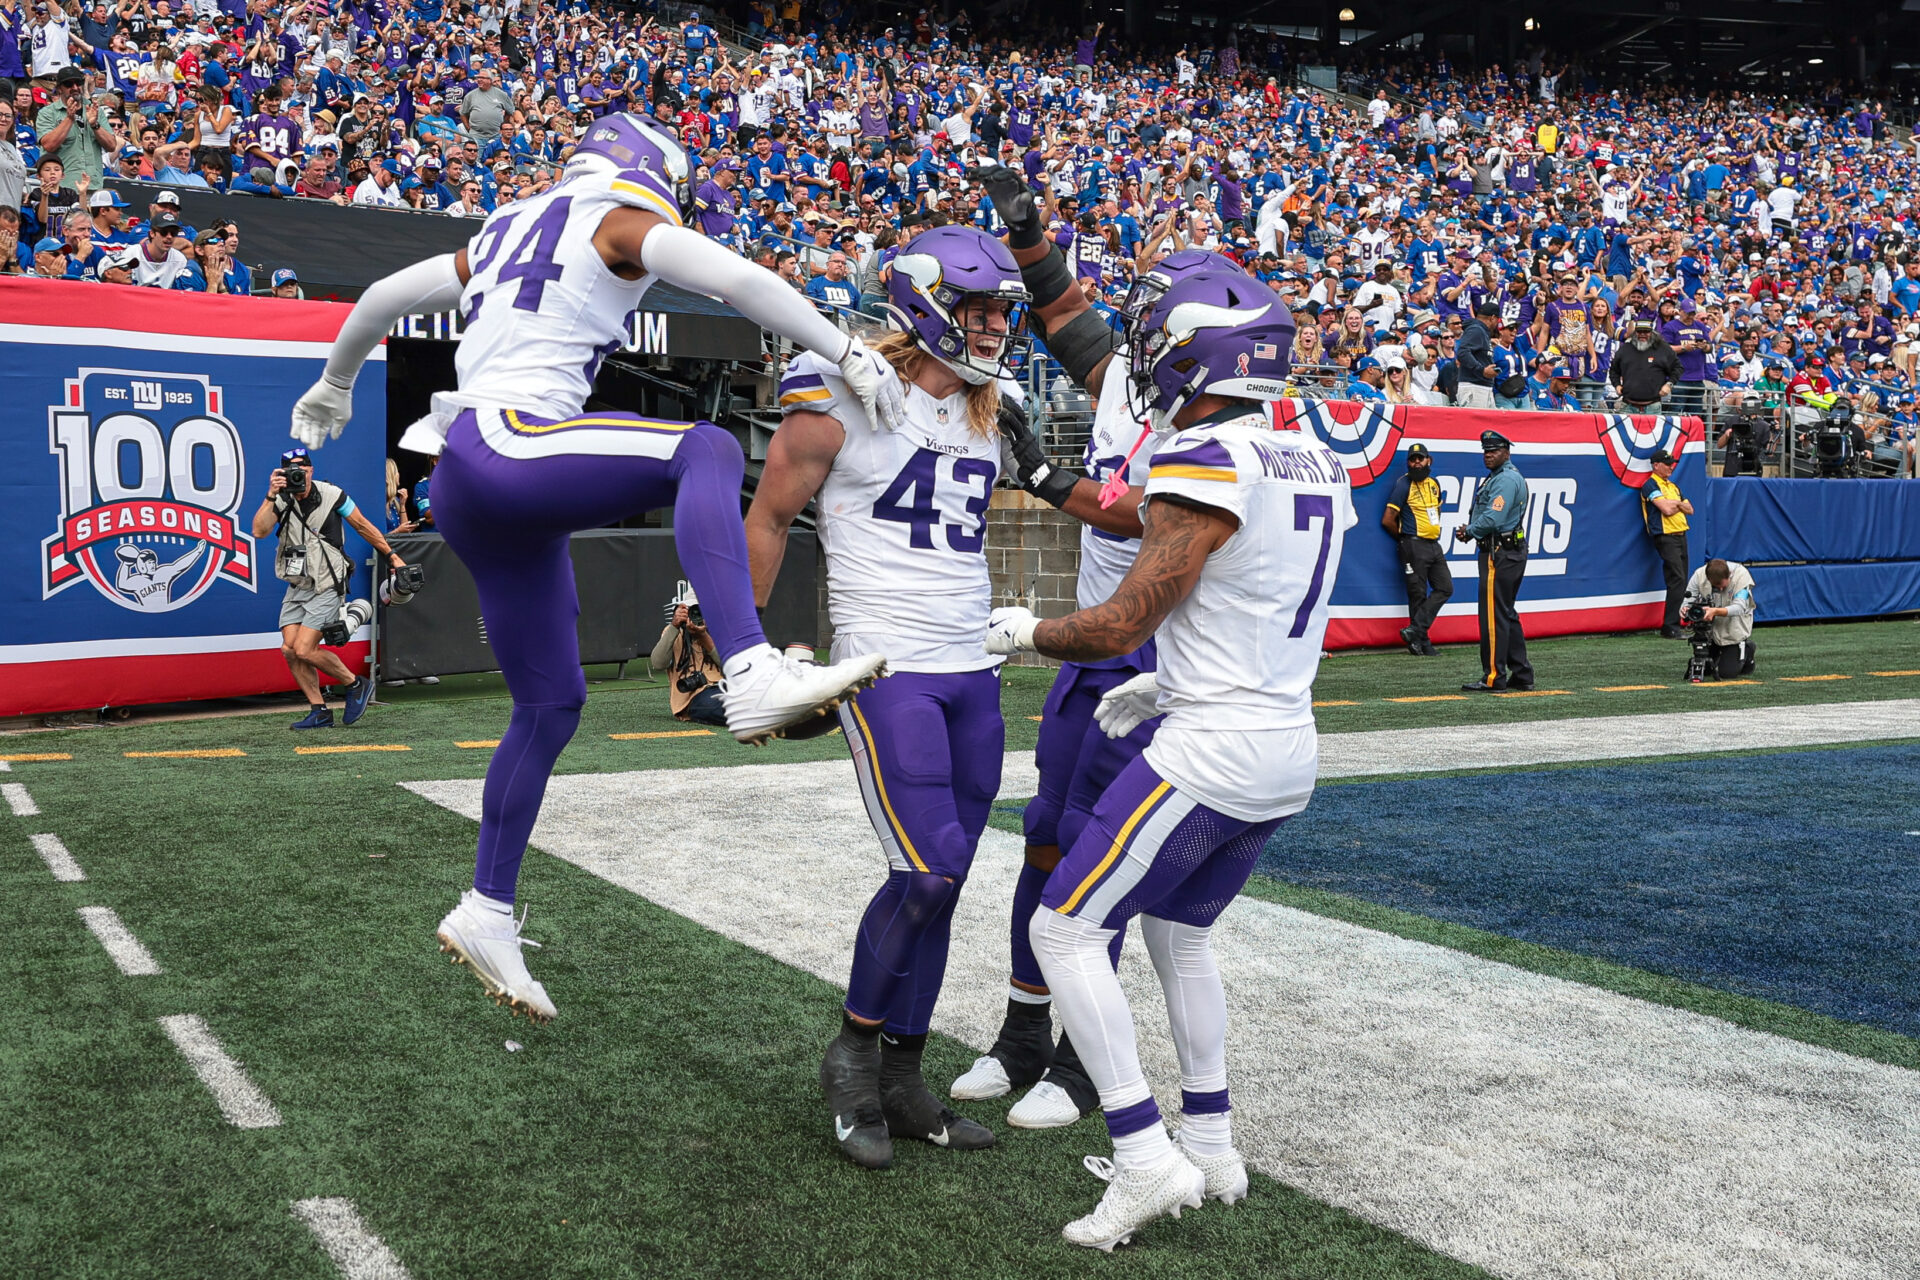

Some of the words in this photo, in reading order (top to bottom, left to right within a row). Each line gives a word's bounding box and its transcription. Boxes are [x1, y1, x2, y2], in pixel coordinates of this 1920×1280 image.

[569, 7, 580, 17] 10
[132, 21, 144, 32] 21
[393, 46, 402, 59] 9
[1438, 64, 1446, 74] 11
[564, 78, 575, 93] 18
[445, 87, 464, 104] 22
[907, 94, 914, 105] 3
[936, 100, 949, 113] 12
[1018, 113, 1030, 124] 18
[716, 125, 725, 139] 5
[834, 123, 846, 135] 12
[259, 126, 289, 153] 84
[813, 162, 829, 180] 92
[1516, 165, 1529, 177] 18
[1255, 181, 1264, 196] 5
[1735, 195, 1746, 208] 17
[473, 195, 576, 313] 24
[1080, 246, 1100, 262] 28
[1363, 242, 1382, 260] 84
[1579, 239, 1586, 253] 5
[1423, 252, 1437, 267] 15
[824, 287, 850, 305] ny
[1503, 301, 1521, 320] 18
[105, 388, 128, 399] EST.
[165, 391, 192, 404] 1925
[1246, 383, 1277, 394] CHOOSE
[56, 413, 238, 515] 100
[1249, 441, 1327, 484] MURPHY
[1030, 463, 1050, 487] NIKE
[872, 448, 997, 553] 43
[76, 506, 222, 540] SEASONS
[1437, 475, 1577, 555] GITS
[1288, 494, 1333, 638] 7
[140, 582, 166, 598] GIANTS
